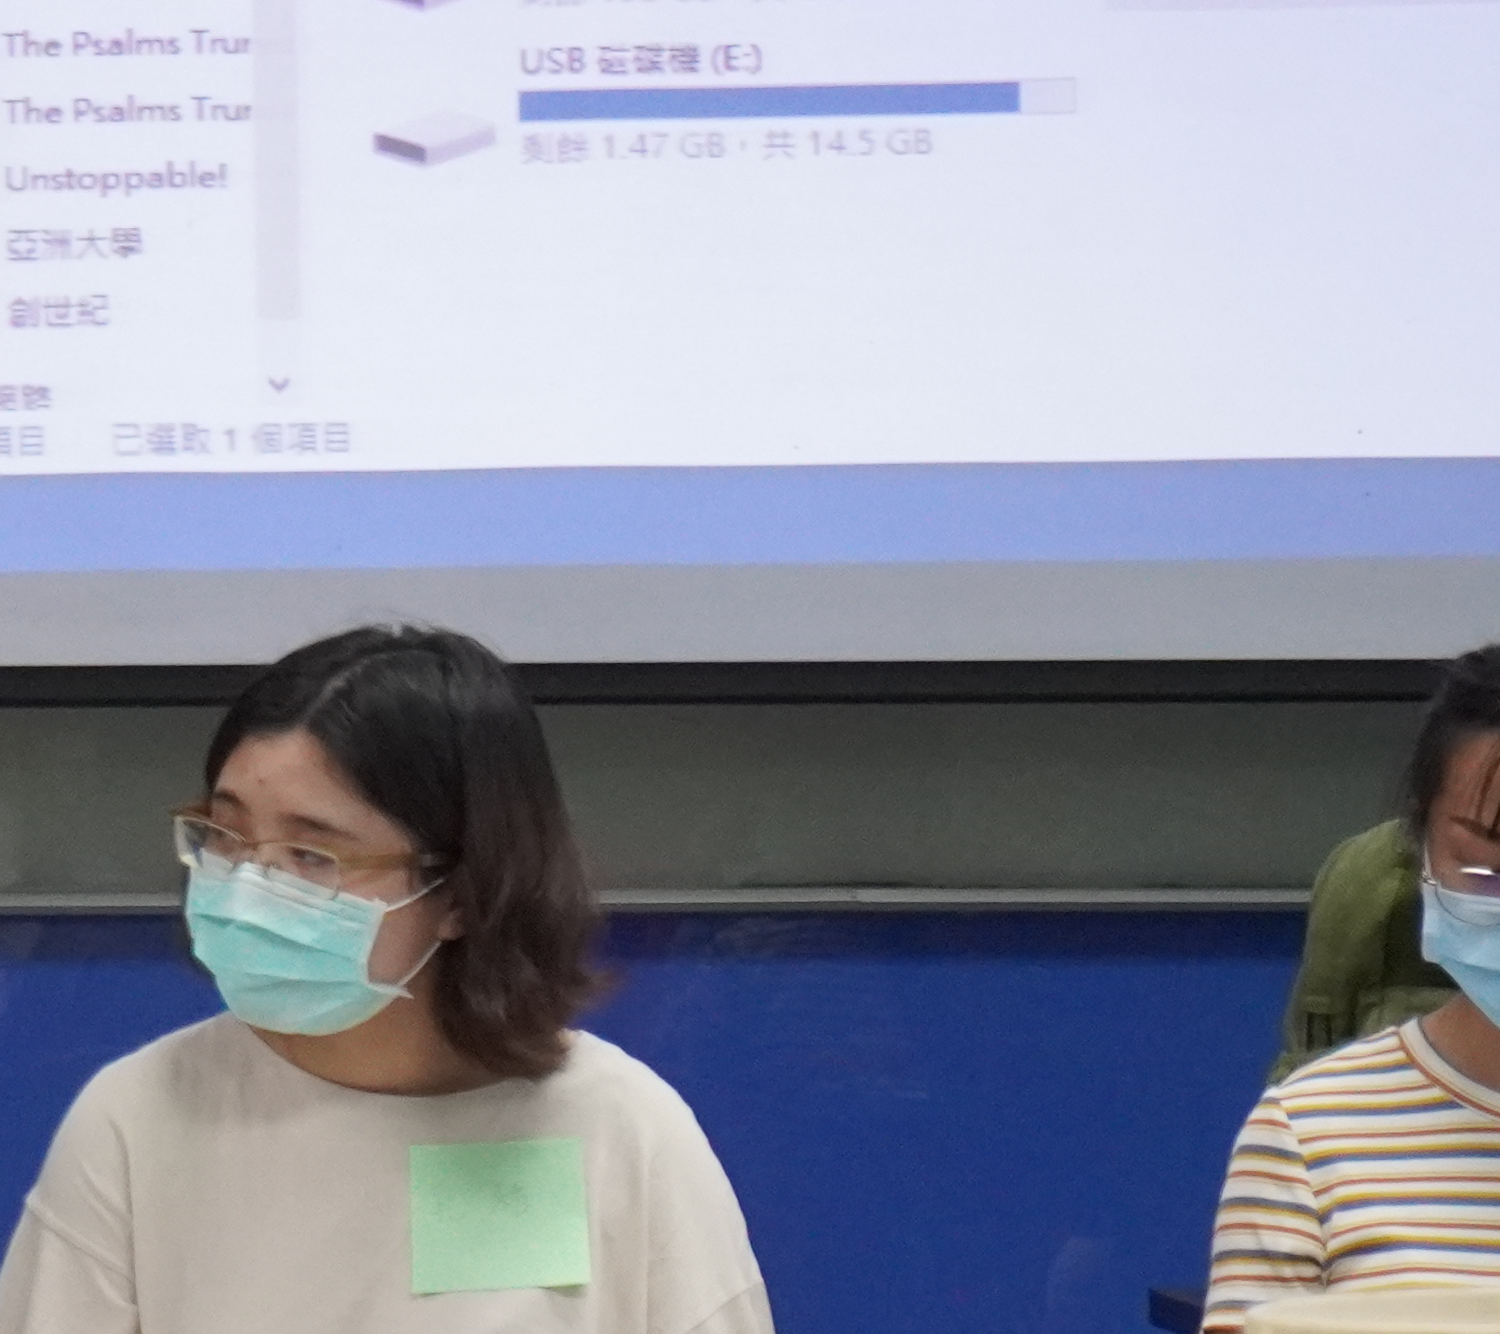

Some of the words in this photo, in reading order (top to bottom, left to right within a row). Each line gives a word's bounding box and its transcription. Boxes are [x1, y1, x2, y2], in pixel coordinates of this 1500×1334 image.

[3, 30, 62, 58] The
[73, 28, 181, 57] Psalms
[521, 47, 586, 75] USB
[3, 96, 63, 125] The
[73, 95, 182, 124] Psalms
[603, 132, 669, 161] 1.47
[810, 128, 876, 157] 14.5
[887, 127, 934, 156] GB
[3, 162, 228, 198] Unstoppable!
[6, 227, 143, 261] 亞洲大學
[8, 295, 110, 328] 創世紀
[112, 423, 212, 457] 已選取
[223, 426, 237, 453] 1
[253, 422, 350, 455] 個項目
